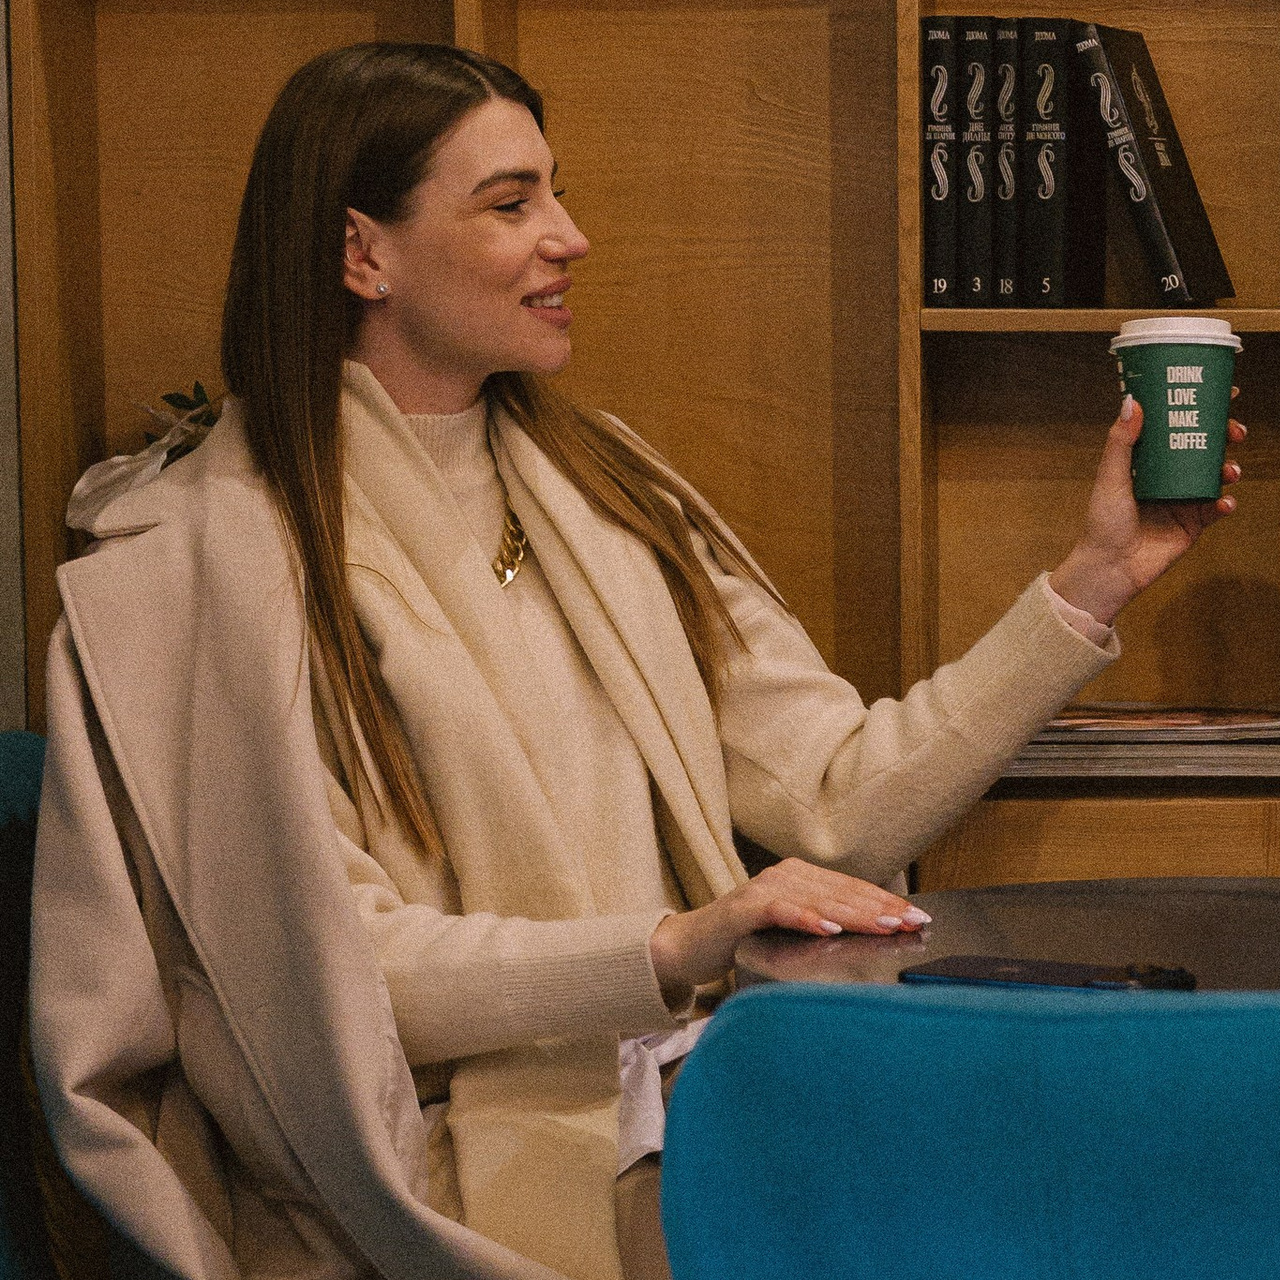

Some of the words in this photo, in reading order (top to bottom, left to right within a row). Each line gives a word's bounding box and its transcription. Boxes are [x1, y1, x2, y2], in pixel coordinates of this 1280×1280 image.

[933, 278, 947, 294] 19
[972, 277, 981, 292] 3
[1000, 278, 1013, 294] 18
[1042, 278, 1051, 293] 5
[1161, 274, 1179, 291] 20
[1166, 365, 1204, 383] DRINK
[1167, 388, 1197, 406] LOVE
[1168, 410, 1200, 428] MAKE
[1169, 432, 1208, 450] COFFEE
